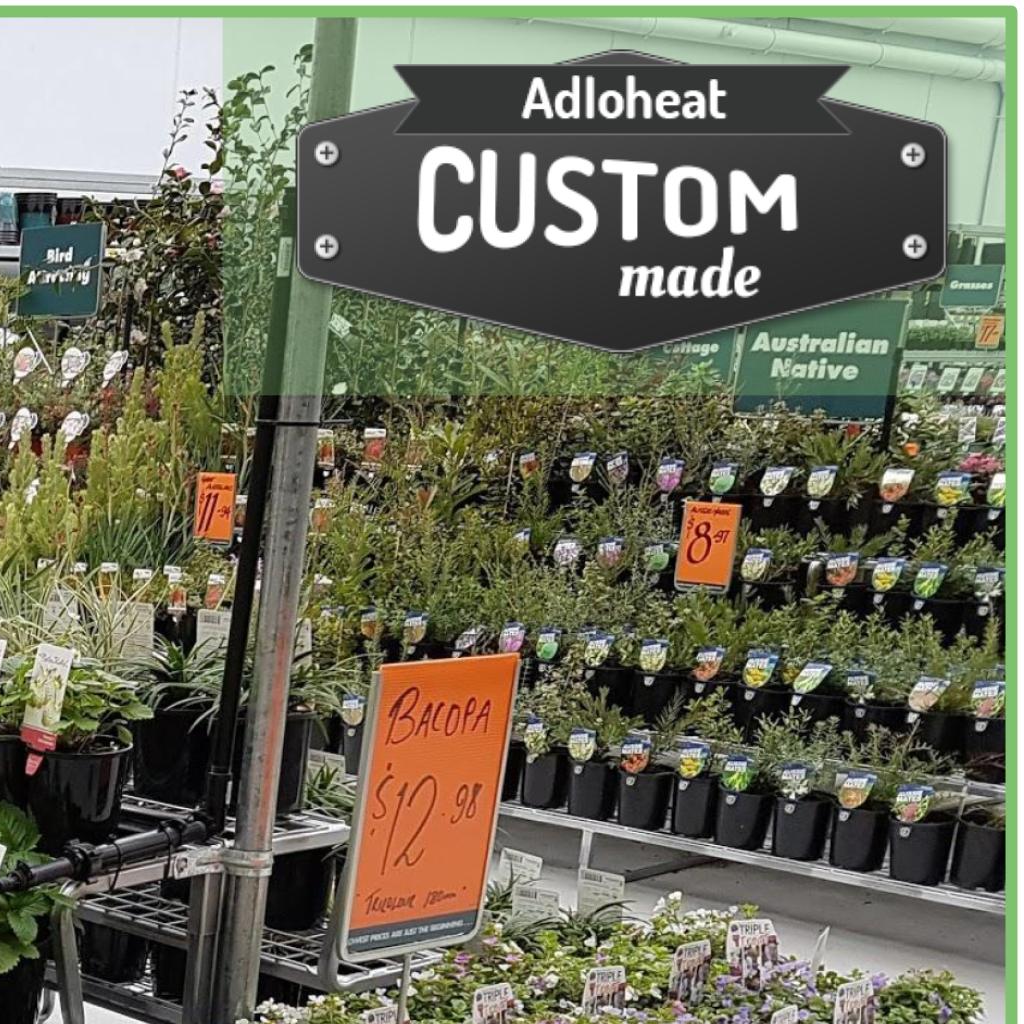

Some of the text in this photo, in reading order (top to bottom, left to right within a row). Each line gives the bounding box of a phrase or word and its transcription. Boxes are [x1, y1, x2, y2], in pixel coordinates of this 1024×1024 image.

[46, 247, 74, 264] Bird
[949, 280, 994, 290] Grasses
[751, 332, 889, 355] Australian
[770, 358, 860, 381] Native
[385, 686, 491, 745] BACOPA
[738, 923, 770, 936] TRIPLE
